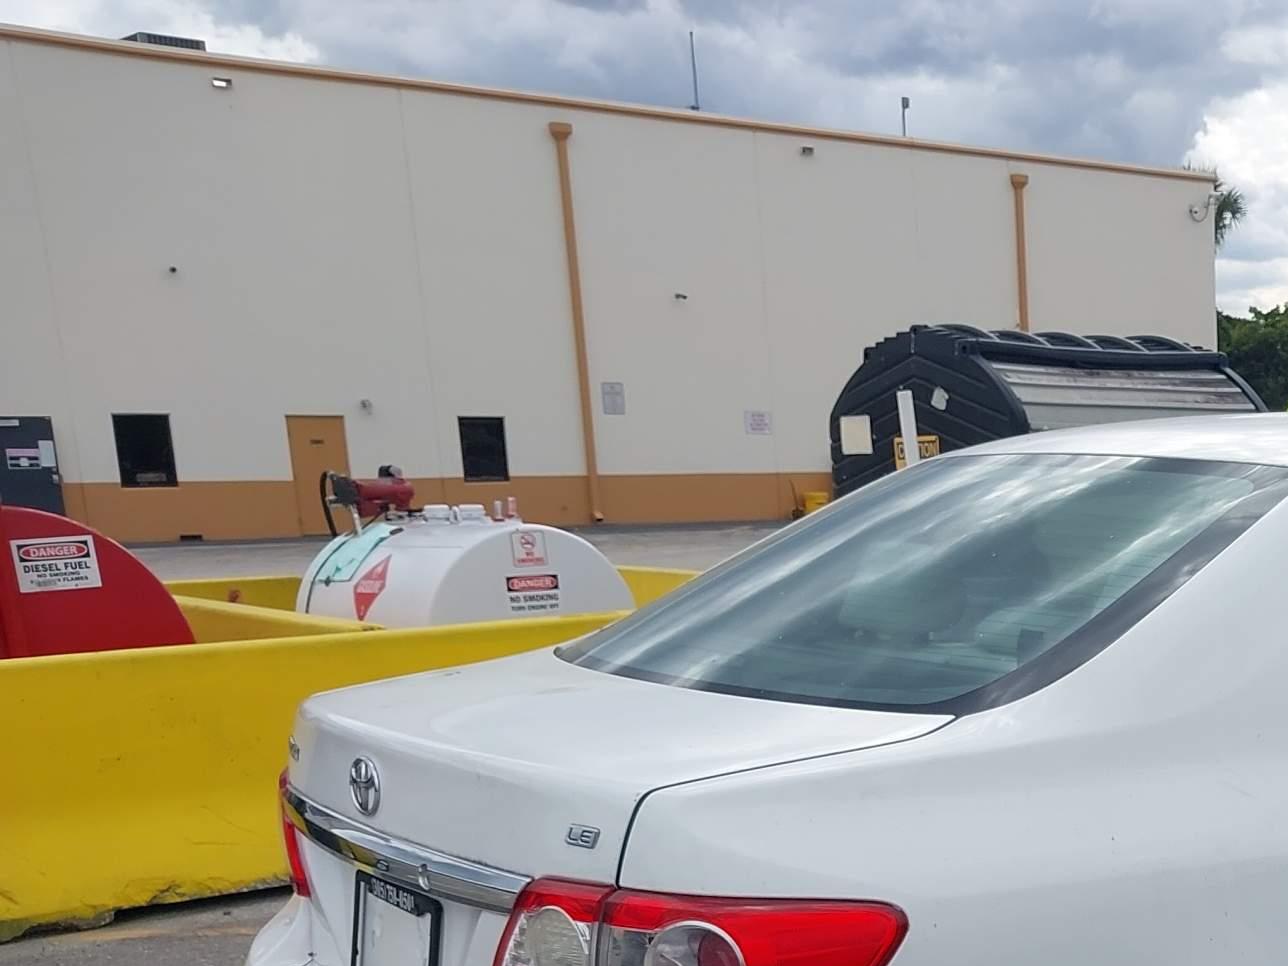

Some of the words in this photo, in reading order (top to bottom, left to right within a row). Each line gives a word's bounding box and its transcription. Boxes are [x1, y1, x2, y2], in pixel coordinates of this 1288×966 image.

[29, 545, 78, 557] DANGER
[23, 562, 61, 573] DIESEL
[64, 561, 91, 570] FUEL
[510, 595, 521, 603] NO
[523, 593, 559, 602] SMOKING
[567, 826, 595, 845] LE
